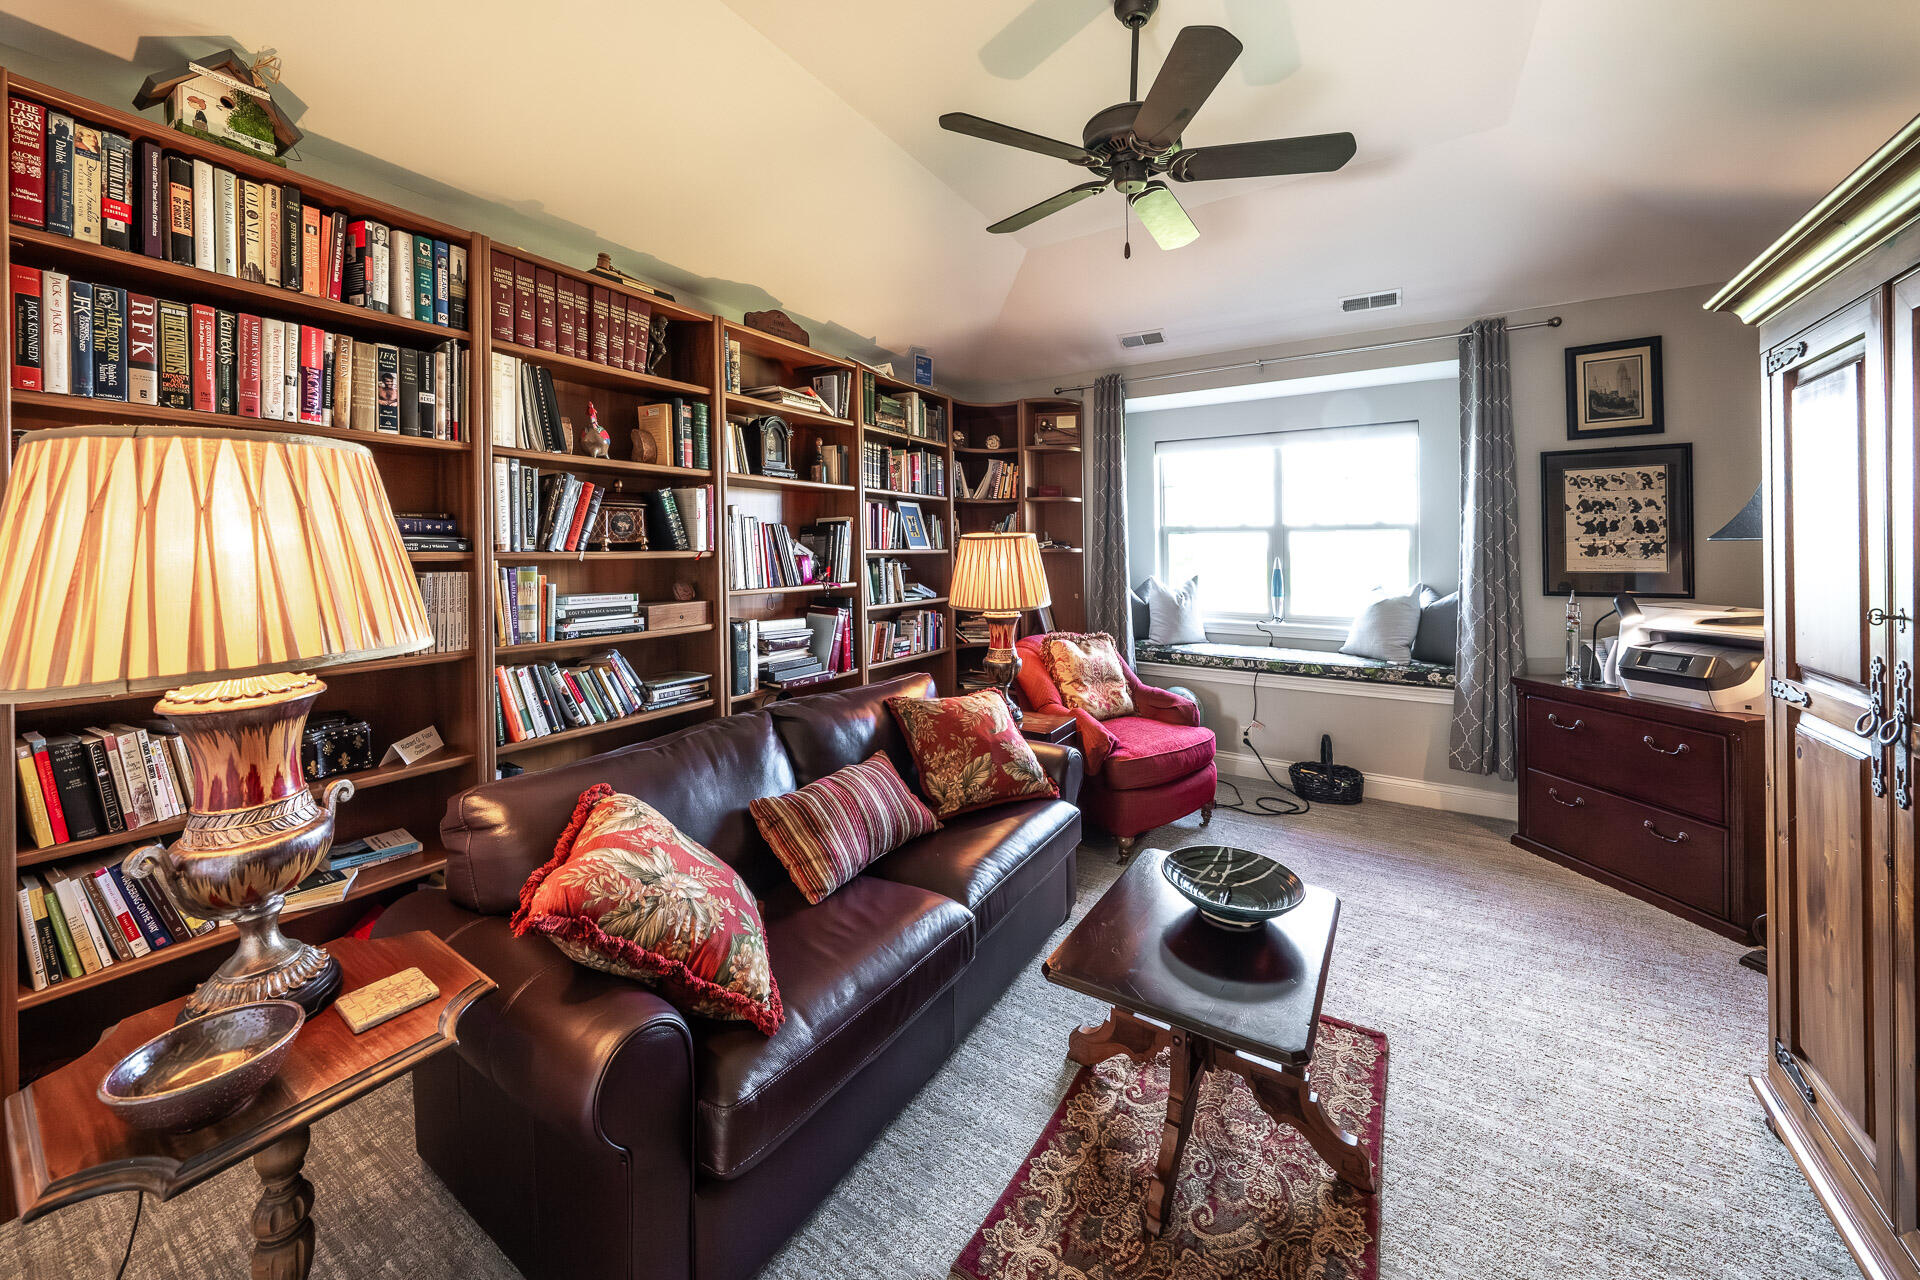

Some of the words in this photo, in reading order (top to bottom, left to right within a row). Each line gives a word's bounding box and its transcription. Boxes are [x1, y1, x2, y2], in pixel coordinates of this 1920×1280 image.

[12, 101, 39, 114] THE
[10, 108, 41, 123] LAST
[10, 116, 41, 131] LION
[12, 125, 39, 137] Winston
[12, 138, 40, 149] Churchill
[14, 131, 37, 142] Spencer
[11, 150, 41, 161] ALONE
[55, 140, 67, 164] Dallek
[82, 160, 97, 192] Benjamin
[110, 151, 123, 200] NIXONLAND
[16, 188, 38, 197] William
[224, 175, 233, 199] TONY
[11, 192, 42, 203] Manchester
[173, 196, 181, 205] OF
[84, 195, 99, 223] Franklin
[173, 203, 182, 228] CHICAGO
[246, 184, 259, 245] COLONEL
[270, 247, 278, 268] Chicago
[494, 272, 512, 281] COMPILED
[495, 267, 512, 276] ILLINOIS
[517, 275, 533, 283] ILLINOIS
[50, 276, 61, 296] JACK
[494, 277, 512, 286] STATUTES
[516, 279, 534, 288] COMPILED
[517, 285, 534, 293] STATUTES
[539, 283, 554, 291] ILLINOIS
[537, 288, 554, 296] COMPILED
[538, 293, 554, 301] STATUTES
[25, 299, 38, 320] JACK
[73, 292, 91, 316] JFK
[50, 308, 63, 335] JACKIE
[94, 308, 105, 325] OUR
[165, 315, 185, 328] THE
[107, 316, 122, 342] HERO
[28, 322, 38, 362] KENNEDY
[94, 328, 108, 352] TIME
[216, 312, 236, 365] Kennedys
[251, 321, 260, 357] AMERICA'S
[108, 344, 119, 361] FOR
[165, 327, 186, 374] KENNEDYS
[340, 338, 349, 356] LAST
[380, 352, 396, 360] JFK
[107, 364, 117, 379] Ralph
[163, 372, 189, 381] DYNASTY
[250, 358, 259, 381] QUEEN
[306, 367, 320, 408] JACKIE
[56, 752, 82, 762] HISTORY
[147, 764, 156, 779] EARTH
[121, 876, 142, 904] WANDERING
[136, 903, 147, 913] ON
[141, 911, 153, 923] THE
[147, 921, 159, 934] WAY
